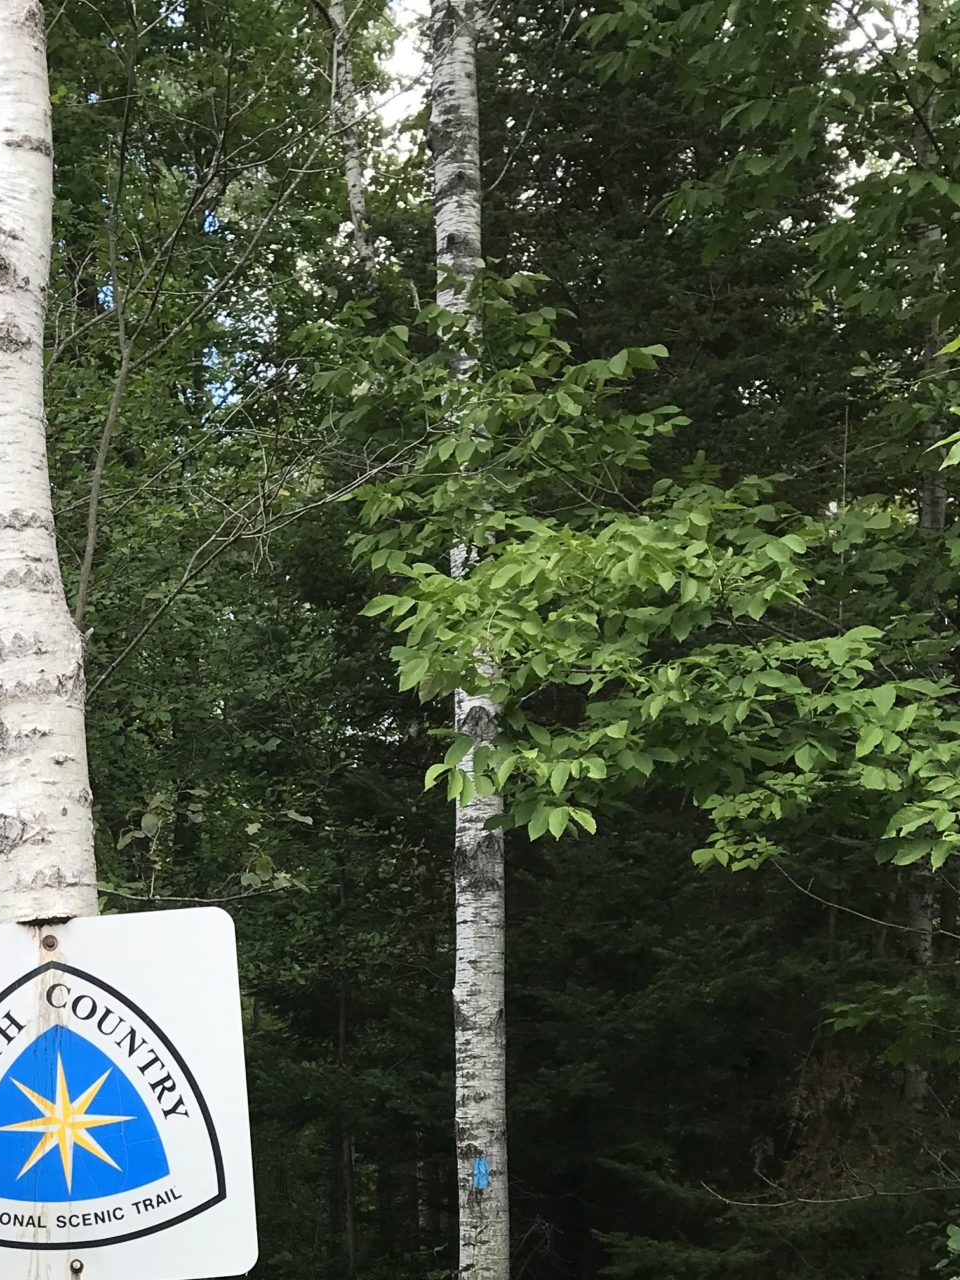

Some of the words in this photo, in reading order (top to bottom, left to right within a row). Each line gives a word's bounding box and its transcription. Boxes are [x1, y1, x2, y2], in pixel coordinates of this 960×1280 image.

[45, 983, 190, 1121] COUNTRY
[56, 1207, 125, 1229] SCENIC
[132, 1187, 183, 1215] TRAIL
